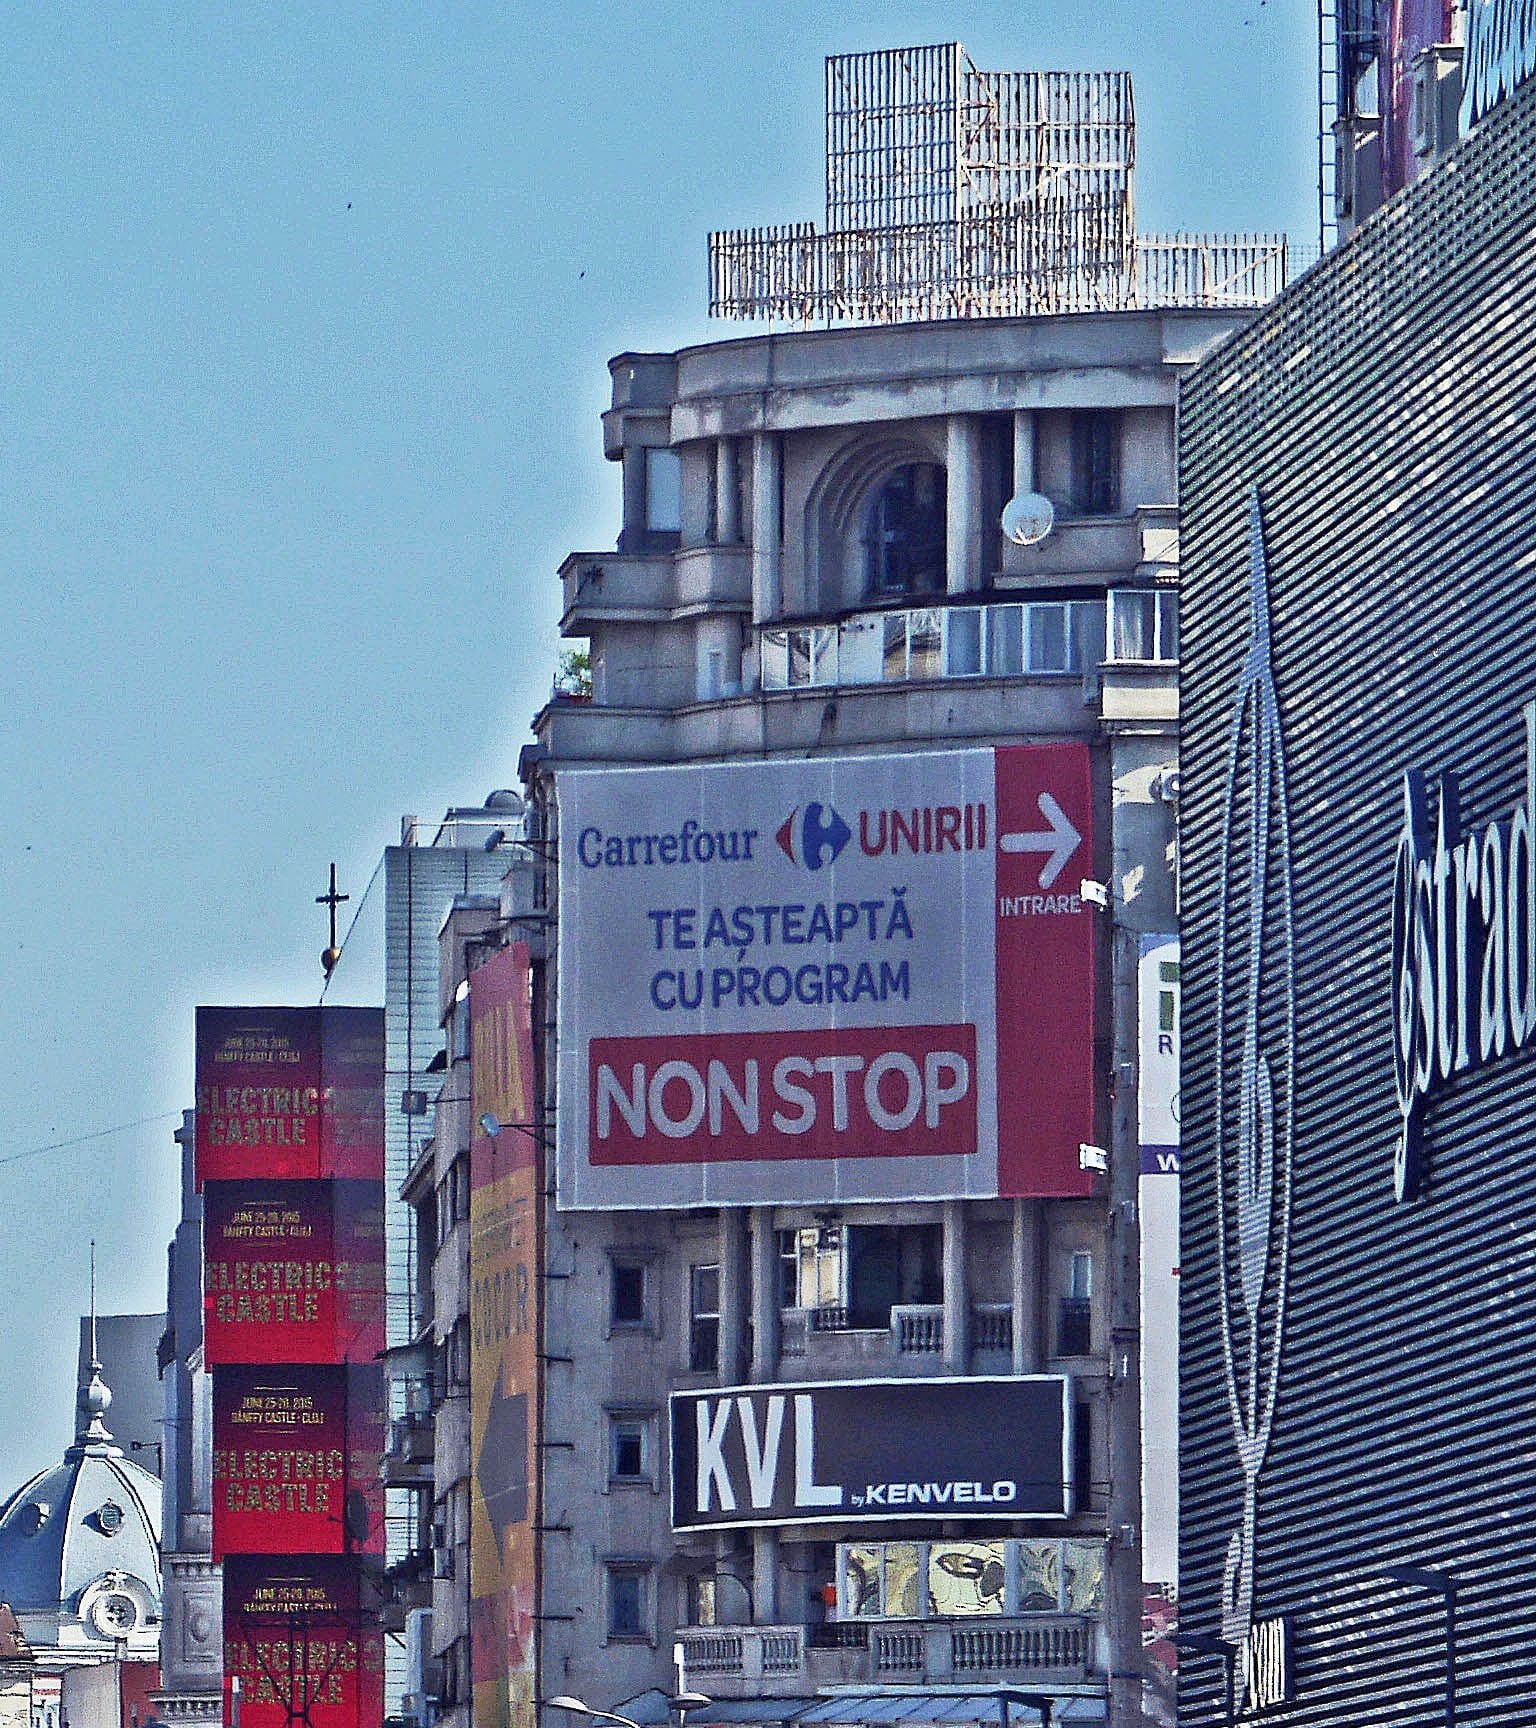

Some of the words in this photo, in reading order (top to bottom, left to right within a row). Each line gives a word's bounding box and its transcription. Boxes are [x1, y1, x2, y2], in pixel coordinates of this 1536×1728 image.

[578, 822, 757, 870] Carrefour
[860, 803, 986, 857] UNIRII
[999, 893, 1081, 917] INTRARE
[649, 909, 694, 949] TE
[704, 886, 913, 963] AȘTEAPTĂ
[650, 969, 704, 1011] CU
[711, 960, 911, 1008] PROGRAM
[596, 1058, 760, 1139] NON
[770, 1050, 970, 1135] STOP
[207, 1118, 307, 1146] CASTLE
[206, 1261, 331, 1291] ELECTRIC
[216, 1293, 319, 1324] CASTLE
[213, 1449, 344, 1481] ELECTRIC
[695, 1394, 842, 1512] KVL
[865, 1480, 1017, 1505] KENVELO
[227, 1482, 329, 1513] CASTLE
